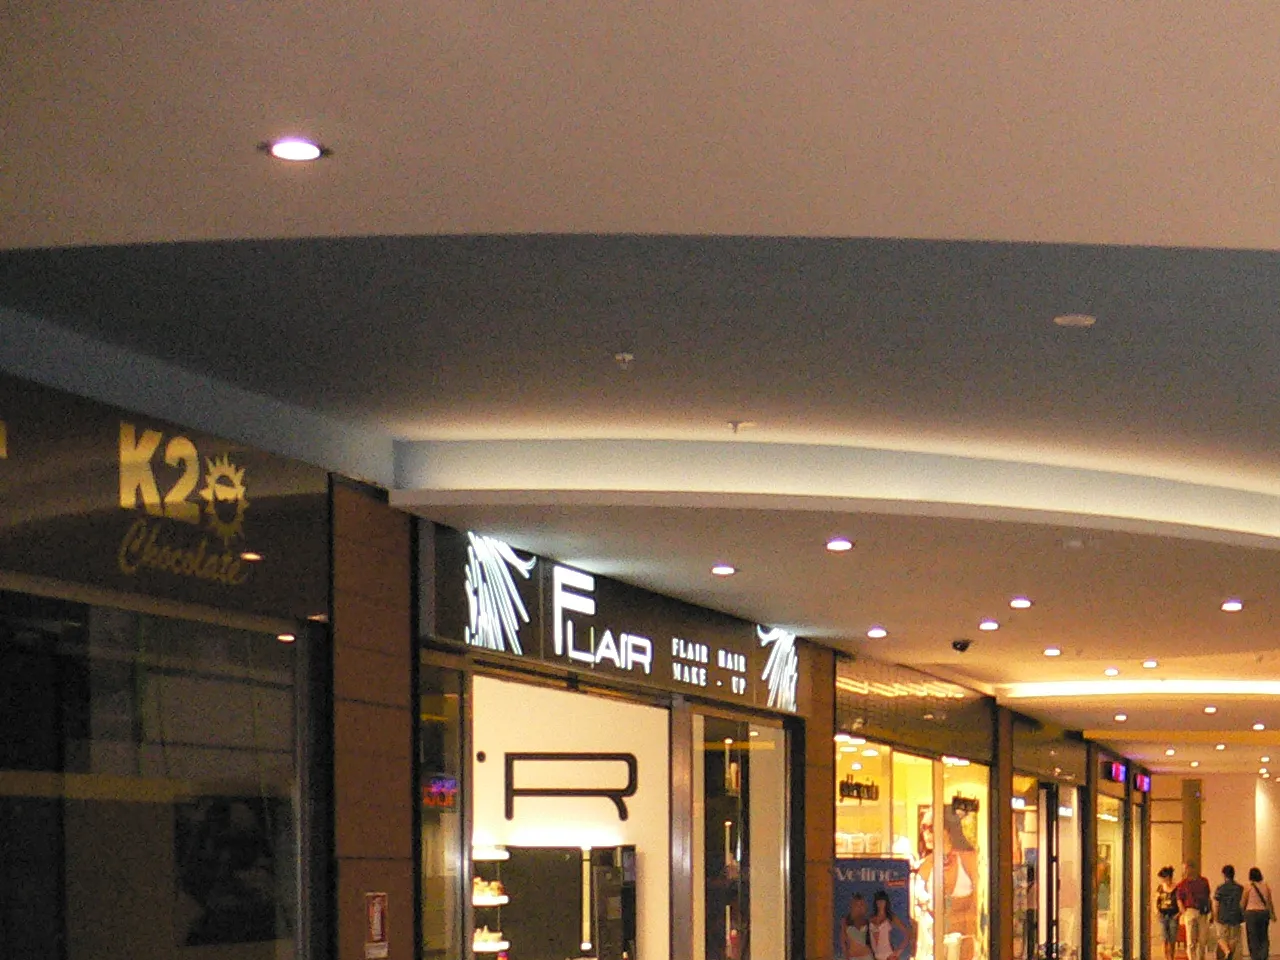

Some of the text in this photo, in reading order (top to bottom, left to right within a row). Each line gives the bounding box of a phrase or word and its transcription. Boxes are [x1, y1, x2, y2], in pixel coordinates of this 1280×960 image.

[119, 421, 200, 524] K2
[118, 516, 247, 586] Chocolate
[553, 565, 653, 675] FLAIR
[671, 637, 747, 673] FLAIR HAIR
[672, 662, 747, 695] MAKE UP
